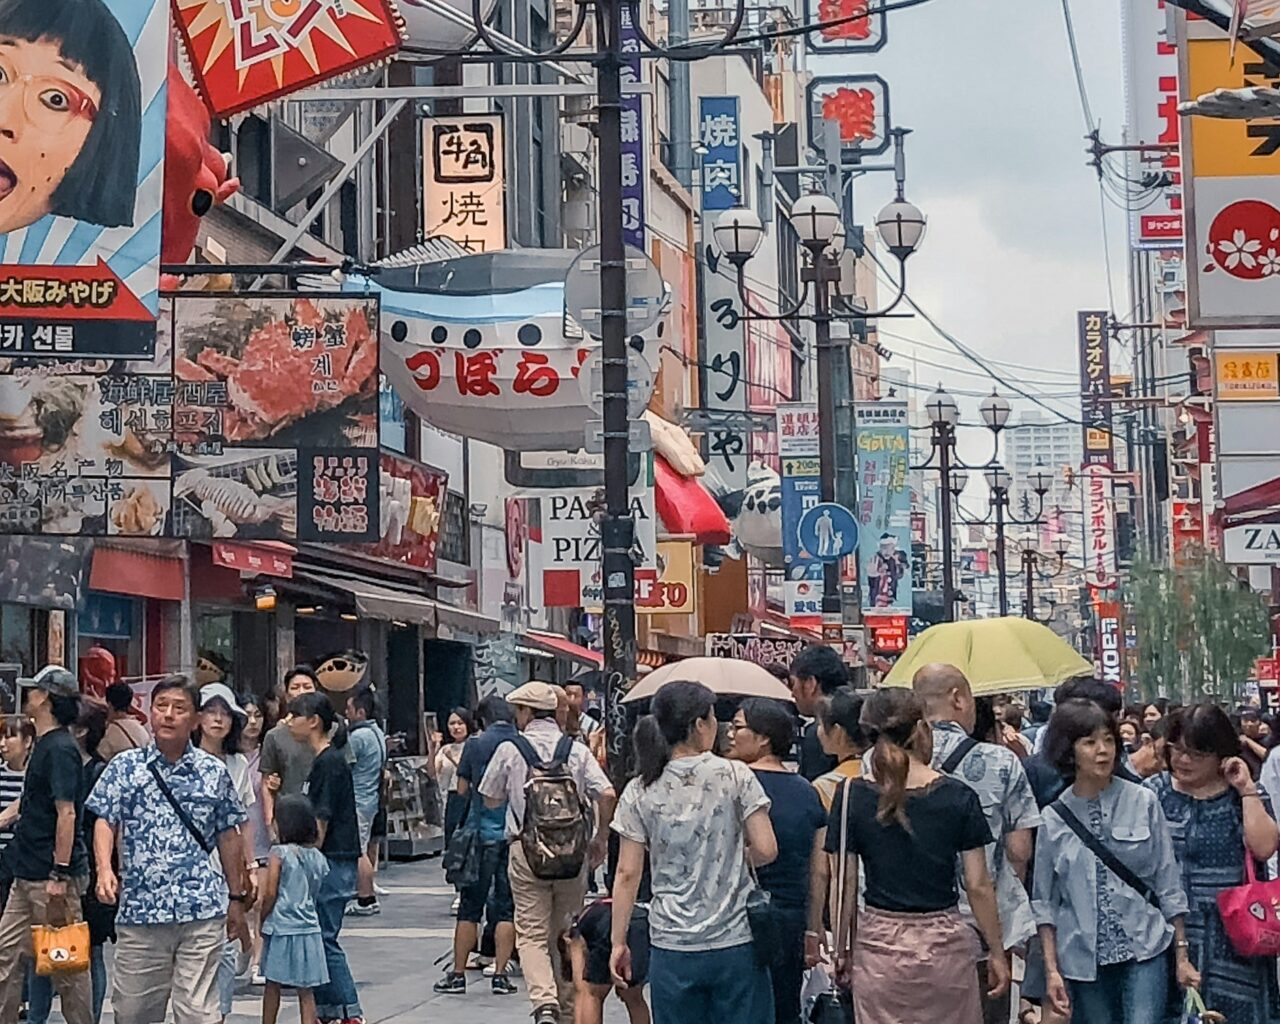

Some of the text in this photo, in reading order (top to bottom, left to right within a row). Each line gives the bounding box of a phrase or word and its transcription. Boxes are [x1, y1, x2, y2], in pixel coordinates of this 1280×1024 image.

[441, 134, 489, 170] 牛角
[700, 113, 738, 195] 焼肉
[32, 326, 75, 352] 선물
[1085, 314, 1104, 379] カラオケ
[549, 495, 650, 521] PAA
[552, 537, 650, 563] PIZA
